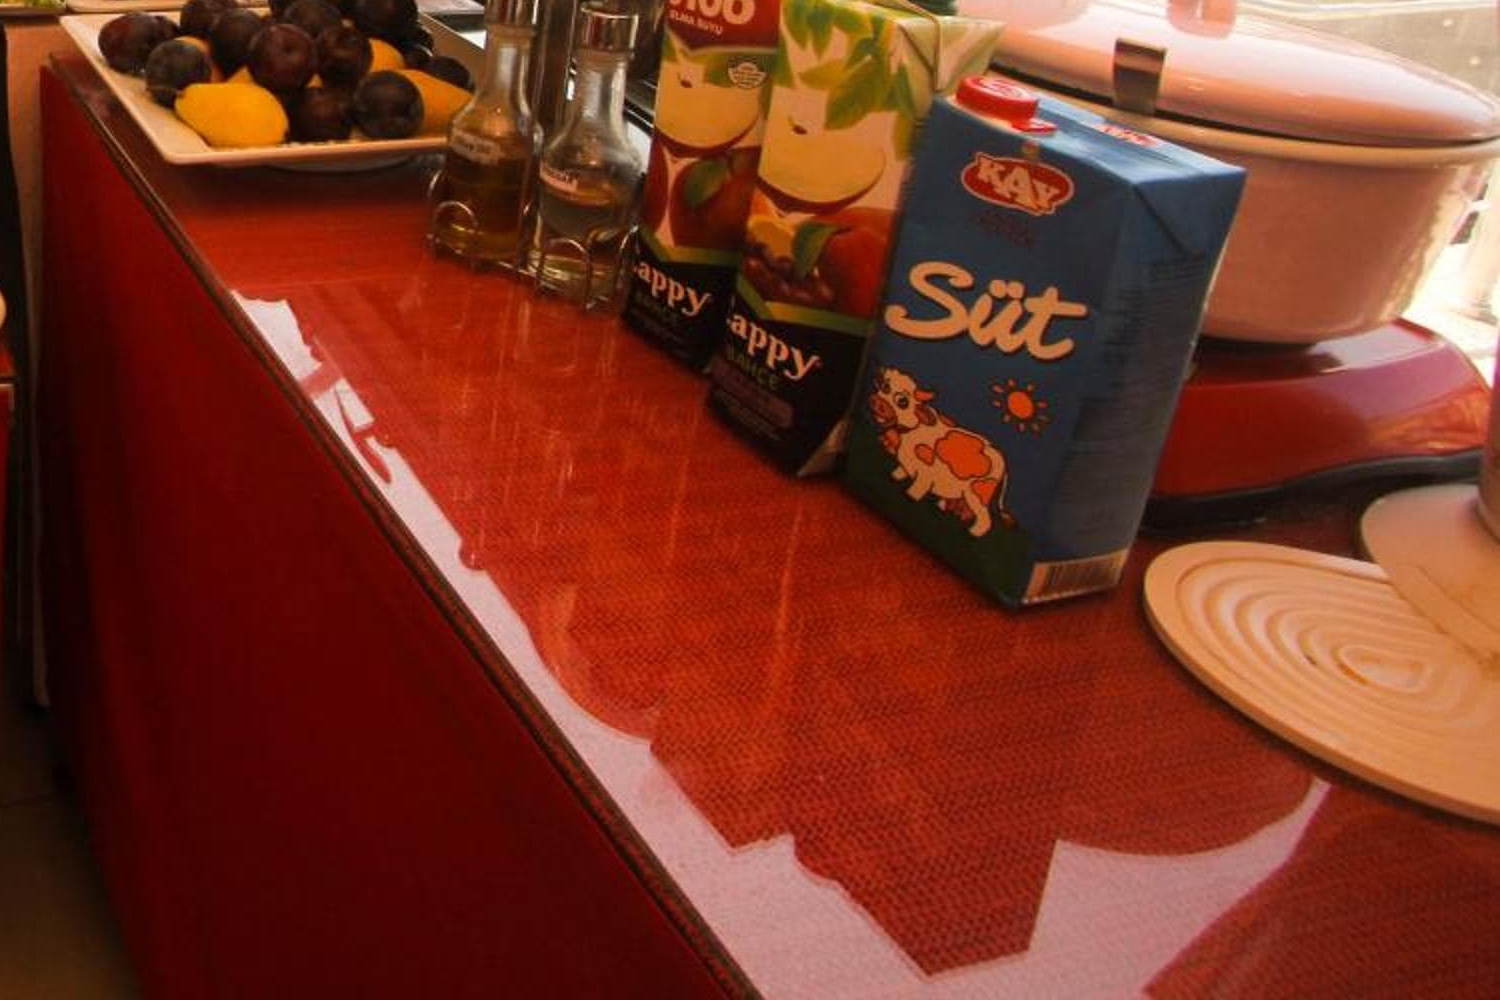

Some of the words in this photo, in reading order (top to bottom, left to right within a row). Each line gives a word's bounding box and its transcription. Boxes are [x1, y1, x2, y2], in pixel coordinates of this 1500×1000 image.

[977, 157, 1062, 212] KAY
[633, 261, 712, 317] appy
[884, 261, 1088, 362] Süt
[726, 313, 821, 381] appy
